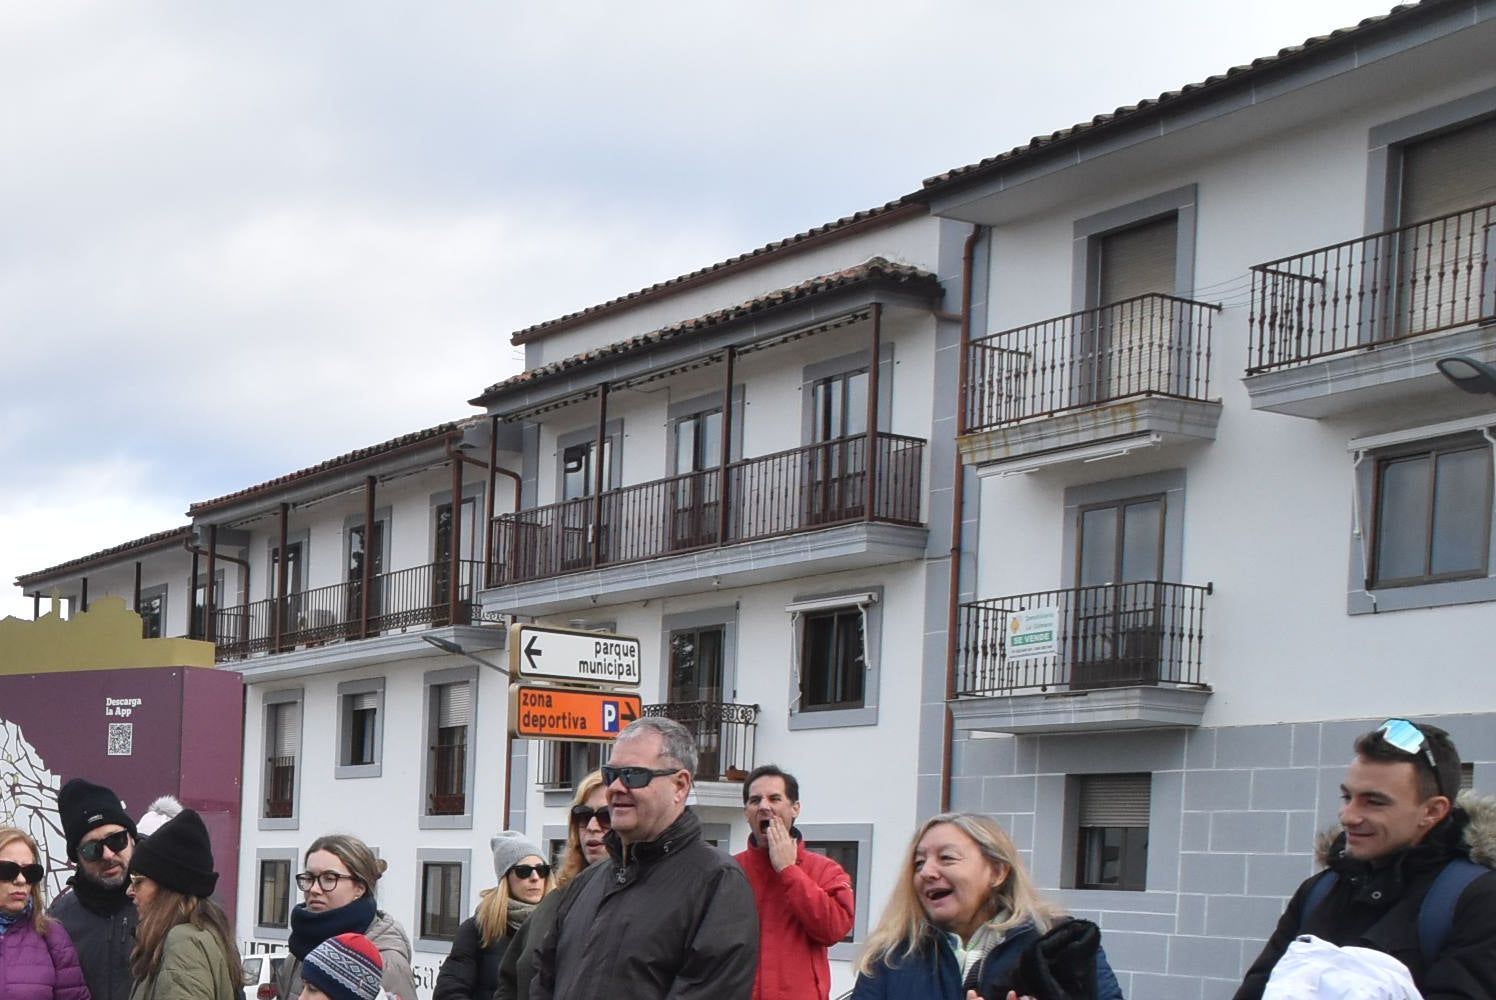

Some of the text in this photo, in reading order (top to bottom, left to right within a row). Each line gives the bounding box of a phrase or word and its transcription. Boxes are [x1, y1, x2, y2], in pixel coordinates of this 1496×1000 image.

[595, 641, 636, 660] parque
[579, 658, 636, 679] municipal
[106, 697, 142, 707] Descarga
[522, 692, 552, 708] zona
[106, 706, 132, 717] la App
[522, 711, 587, 731] deportiva
